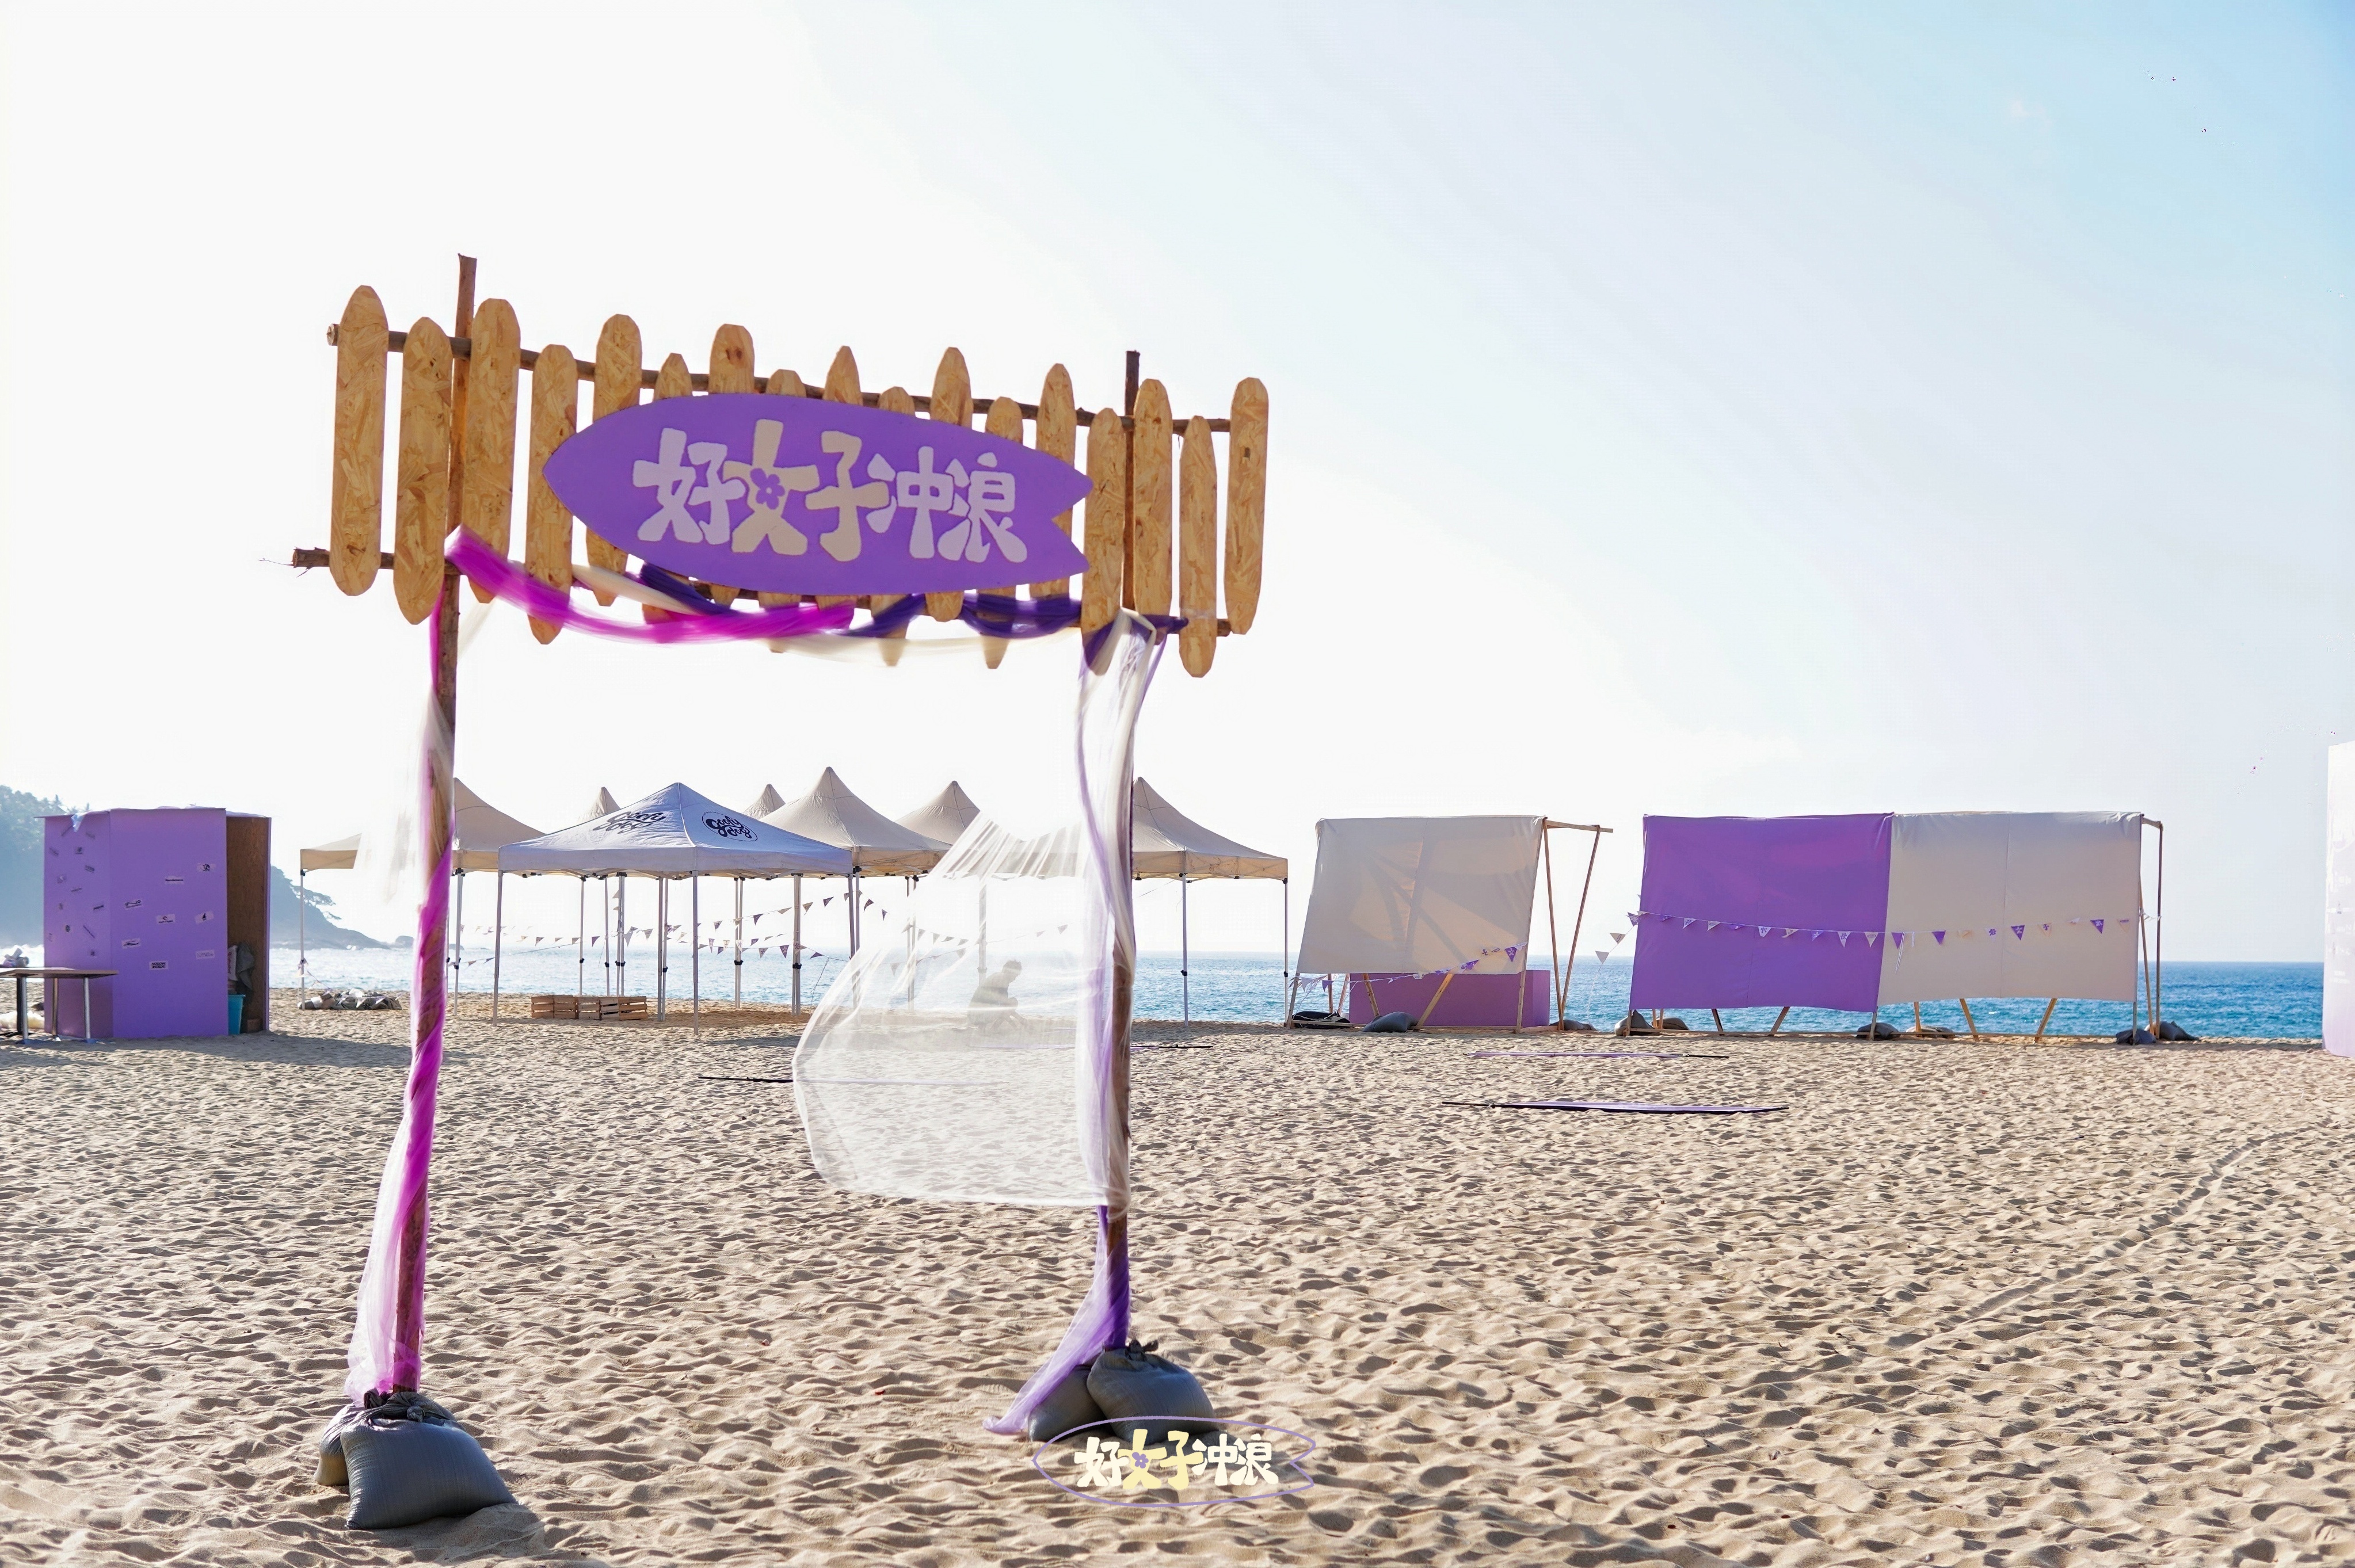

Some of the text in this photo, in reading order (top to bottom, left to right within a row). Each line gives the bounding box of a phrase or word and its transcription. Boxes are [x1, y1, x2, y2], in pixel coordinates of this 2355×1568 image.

[632, 418, 1028, 563] 好女子冲浪
